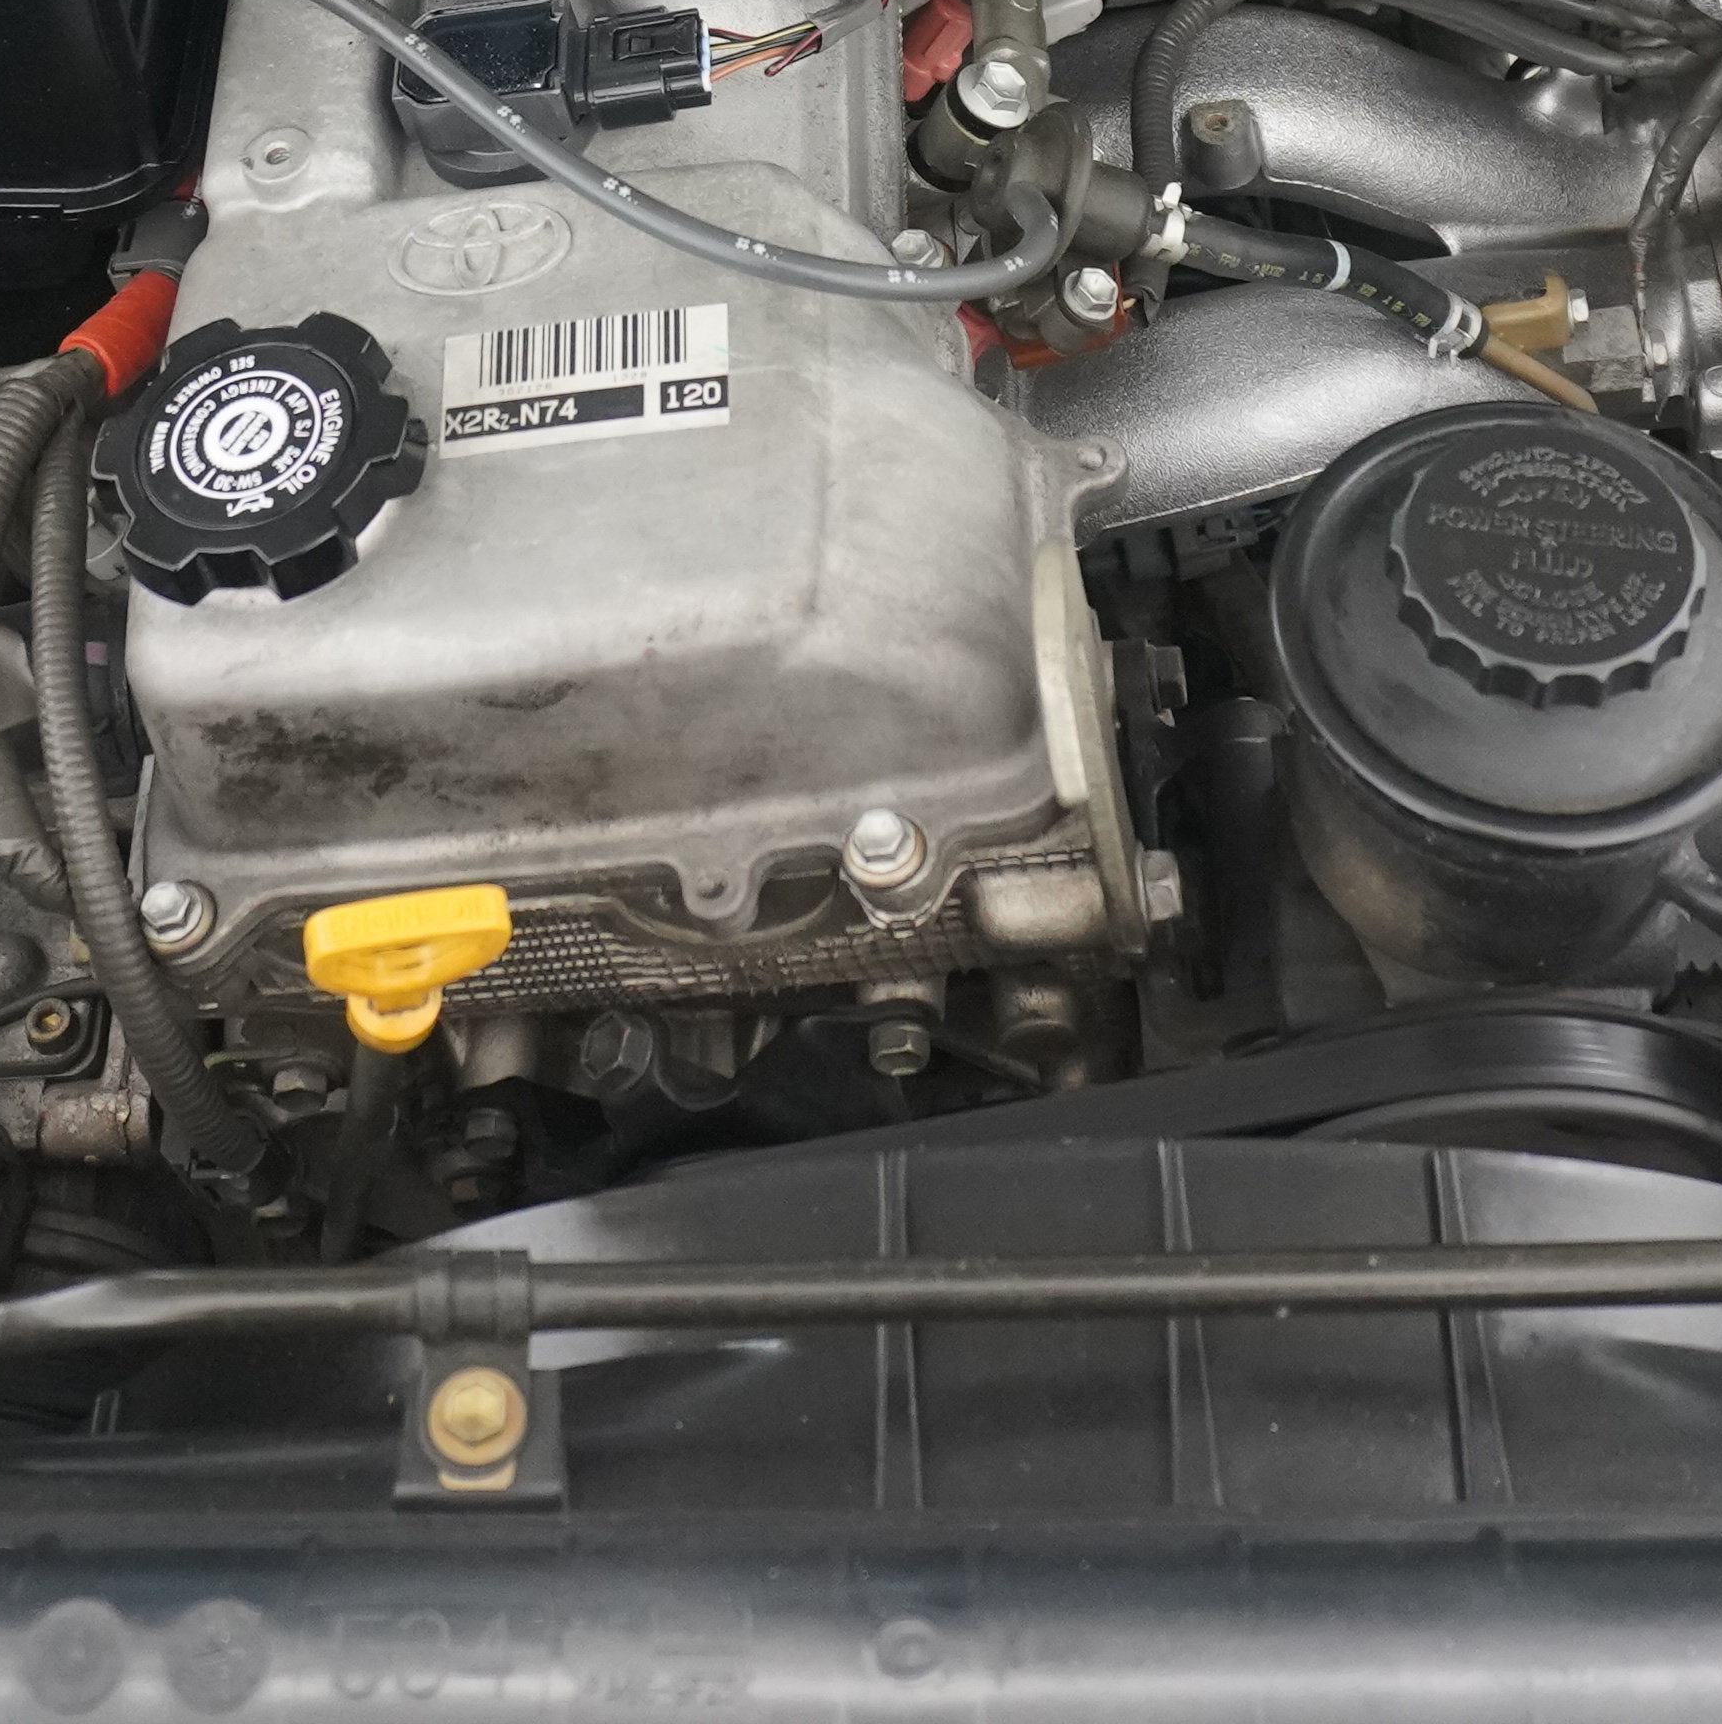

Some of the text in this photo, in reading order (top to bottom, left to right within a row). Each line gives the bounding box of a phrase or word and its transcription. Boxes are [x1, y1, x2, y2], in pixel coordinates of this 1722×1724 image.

[219, 378, 278, 403] ENERGY
[284, 391, 310, 415] API
[666, 380, 723, 410] 120
[149, 354, 256, 475] SEE OWNER'S MANUAL
[293, 418, 313, 438] SJ
[180, 398, 218, 478] CONSERVING
[277, 387, 345, 496] ENGINE OIL
[270, 444, 303, 474] SAE
[212, 470, 263, 492] 5W-30
